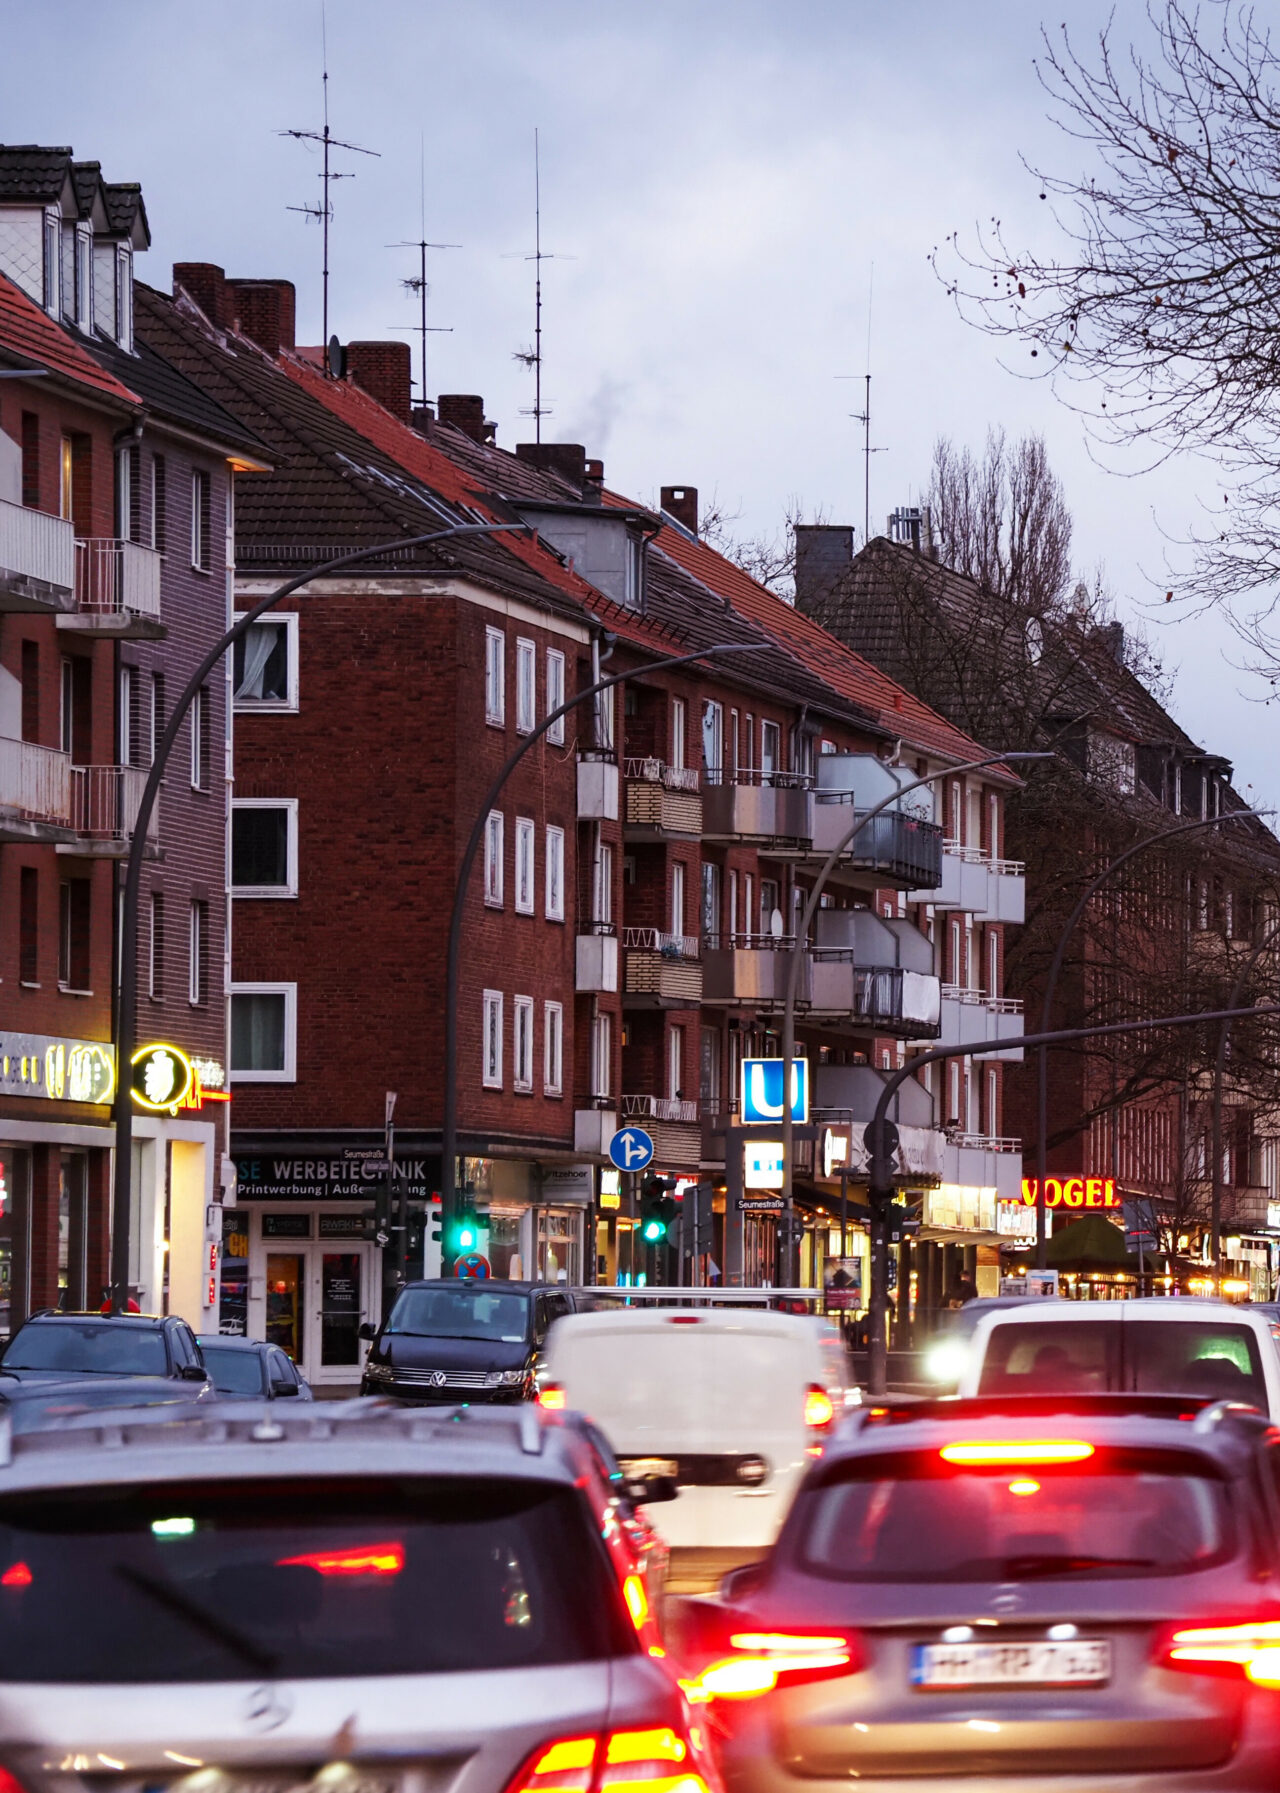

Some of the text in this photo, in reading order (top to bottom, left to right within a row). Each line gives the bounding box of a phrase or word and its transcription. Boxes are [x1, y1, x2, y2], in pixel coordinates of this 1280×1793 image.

[751, 1064, 798, 1117] U
[344, 1150, 384, 1159] Seumestraße
[273, 1160, 426, 1180] WERBETECNIK
[238, 1184, 322, 1196] Printwerbung
[738, 1200, 785, 1209] Seumestraße
